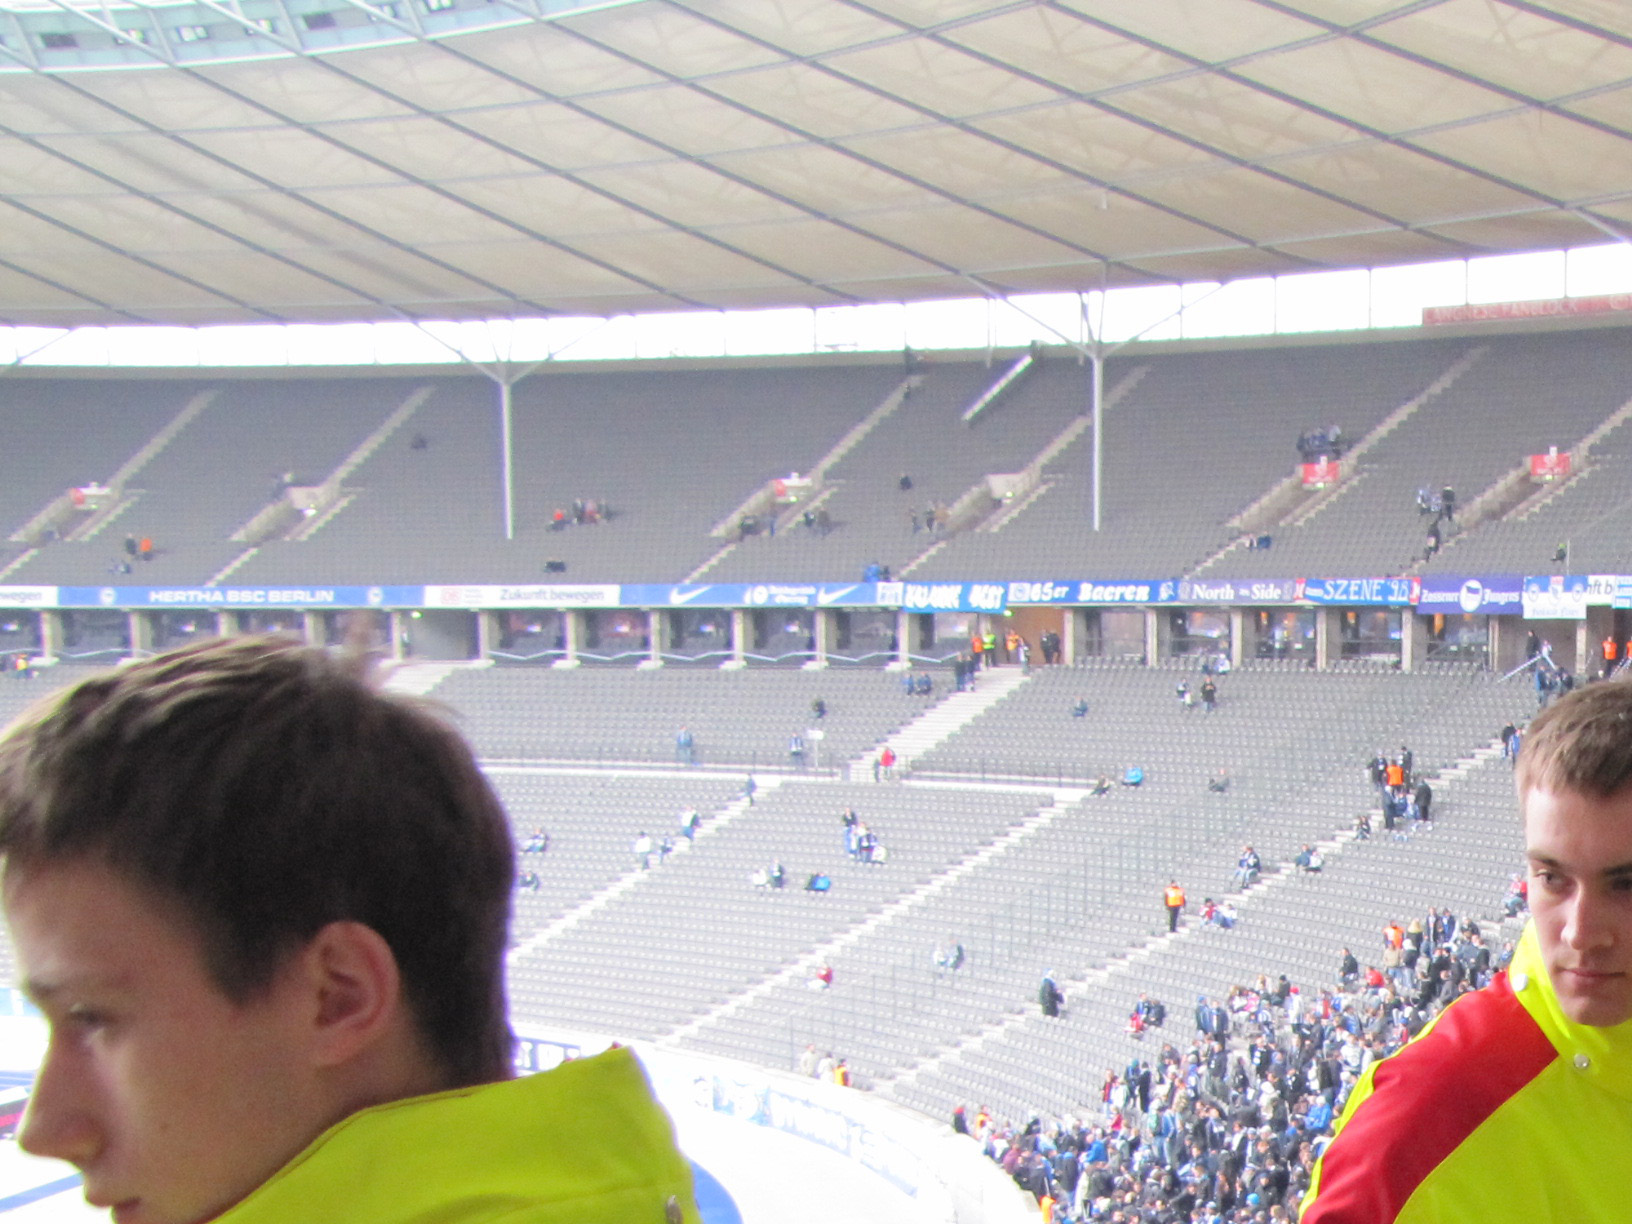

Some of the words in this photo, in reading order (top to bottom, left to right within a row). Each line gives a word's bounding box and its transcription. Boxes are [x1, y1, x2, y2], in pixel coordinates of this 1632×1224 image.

[150, 590, 225, 603] HERTHA
[227, 590, 265, 602] BSC
[268, 590, 335, 602] BERLIN
[550, 588, 605, 603] bewegen
[1192, 583, 1235, 601] North
[1251, 583, 1282, 601] Side
[1323, 579, 1386, 602] SZENE
